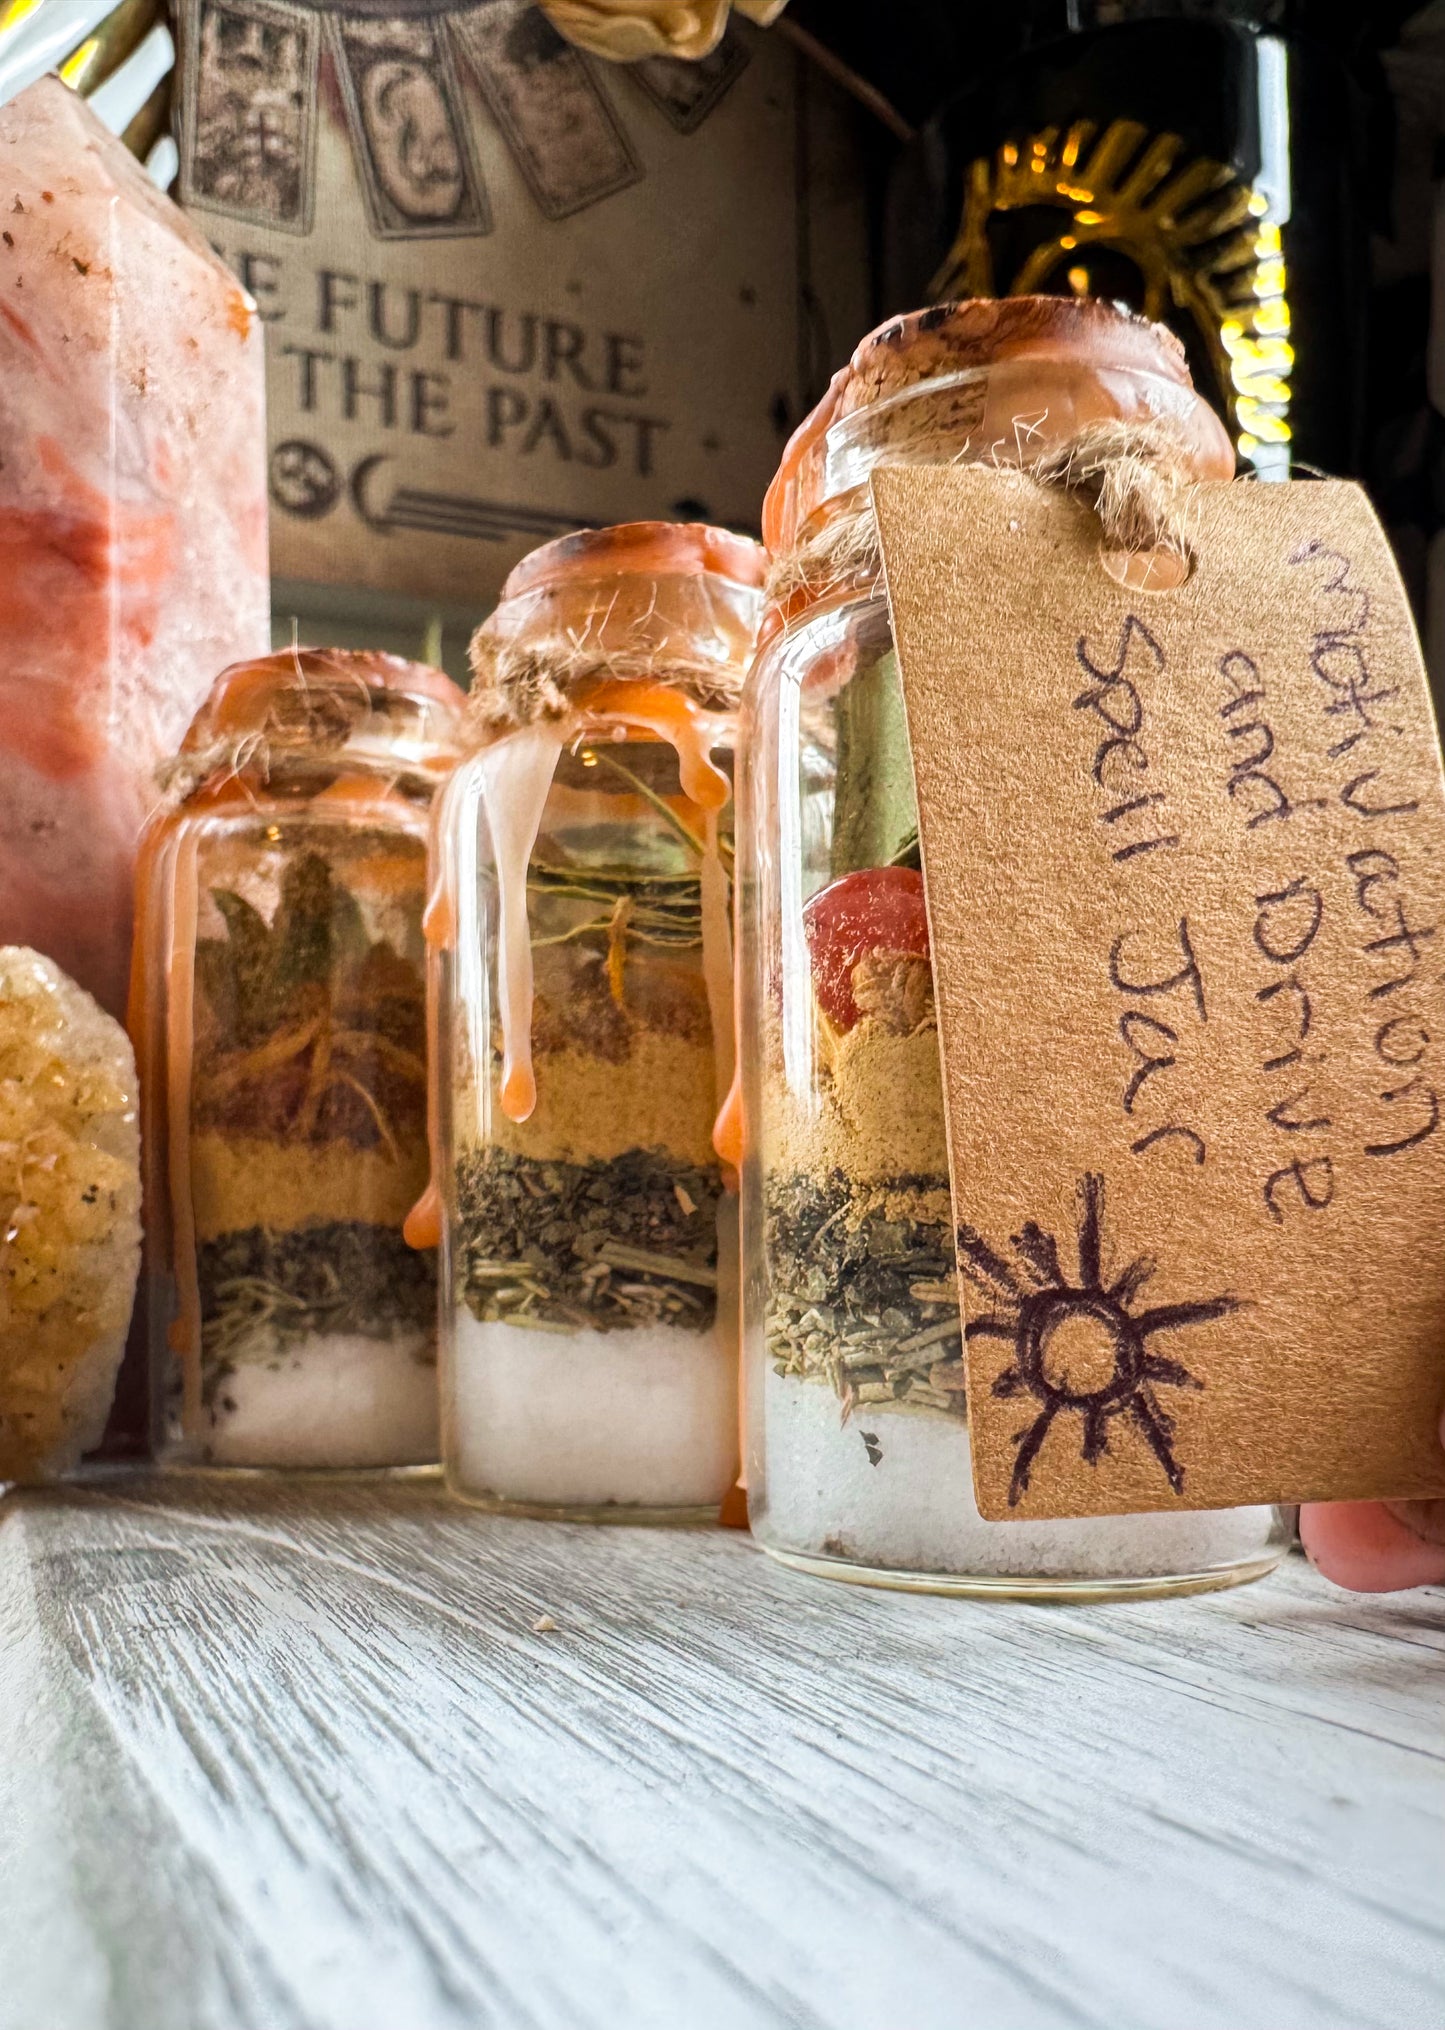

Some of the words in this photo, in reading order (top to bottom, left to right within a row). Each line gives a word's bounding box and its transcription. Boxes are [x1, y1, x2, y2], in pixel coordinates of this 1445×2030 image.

[282, 343, 457, 438] THE
[487, 385, 671, 479] PAST
[317, 267, 649, 398] FUTURE
[1073, 614, 1180, 862] Spell
[1219, 650, 1327, 829] and
[1108, 915, 1207, 1166] Jar
[1254, 876, 1333, 1225] Drive
